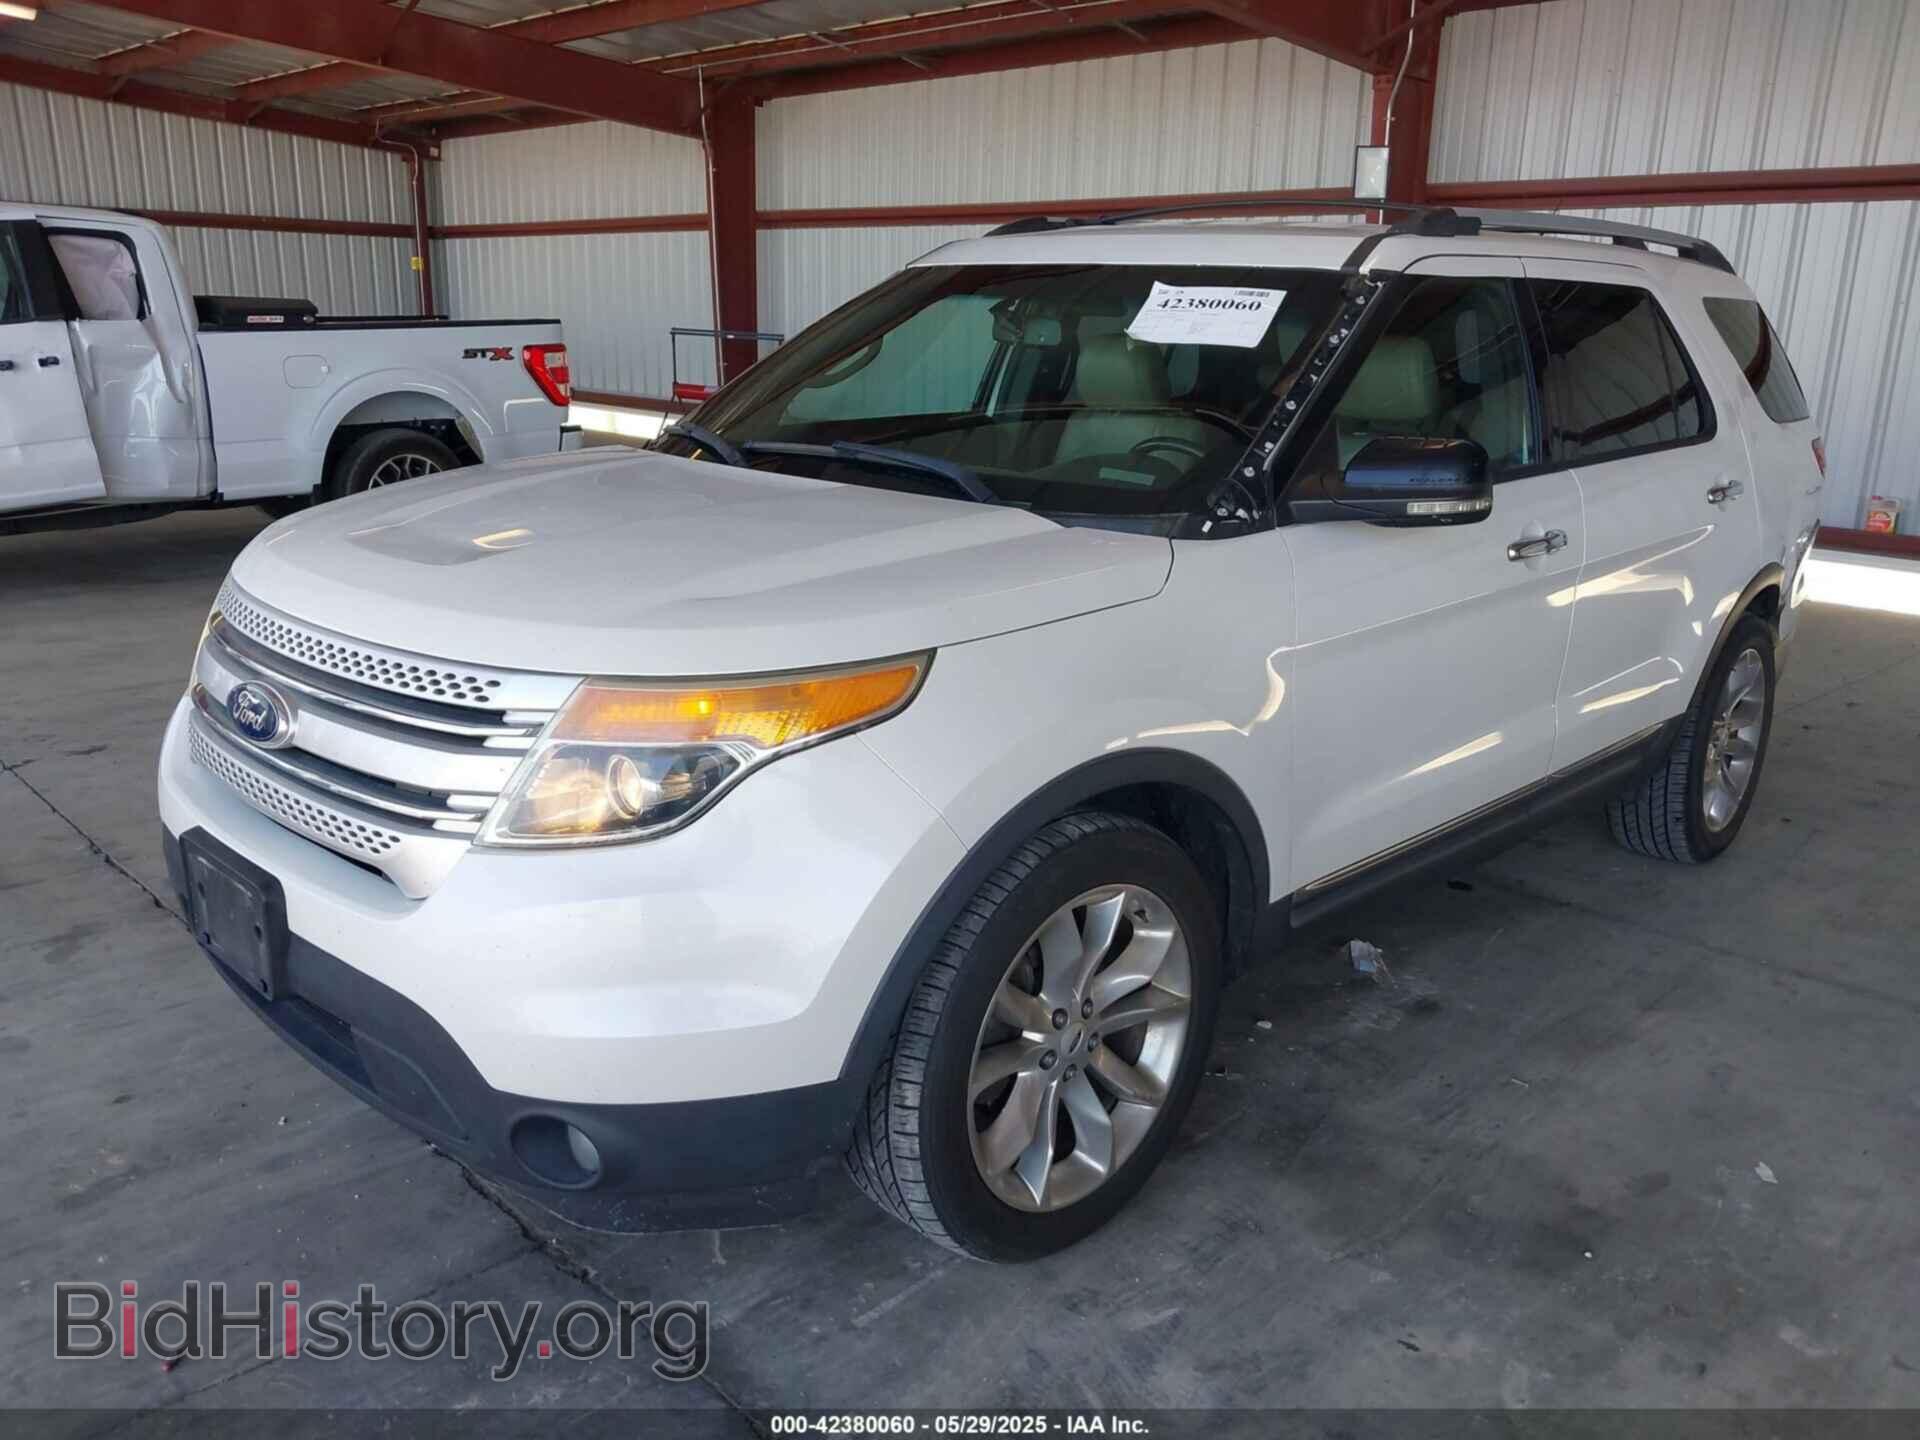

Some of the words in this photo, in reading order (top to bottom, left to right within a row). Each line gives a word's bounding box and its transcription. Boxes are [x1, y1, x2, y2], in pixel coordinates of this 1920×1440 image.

[1157, 298, 1262, 311] 42380060
[462, 347, 515, 361] STX
[232, 690, 267, 731] Ford
